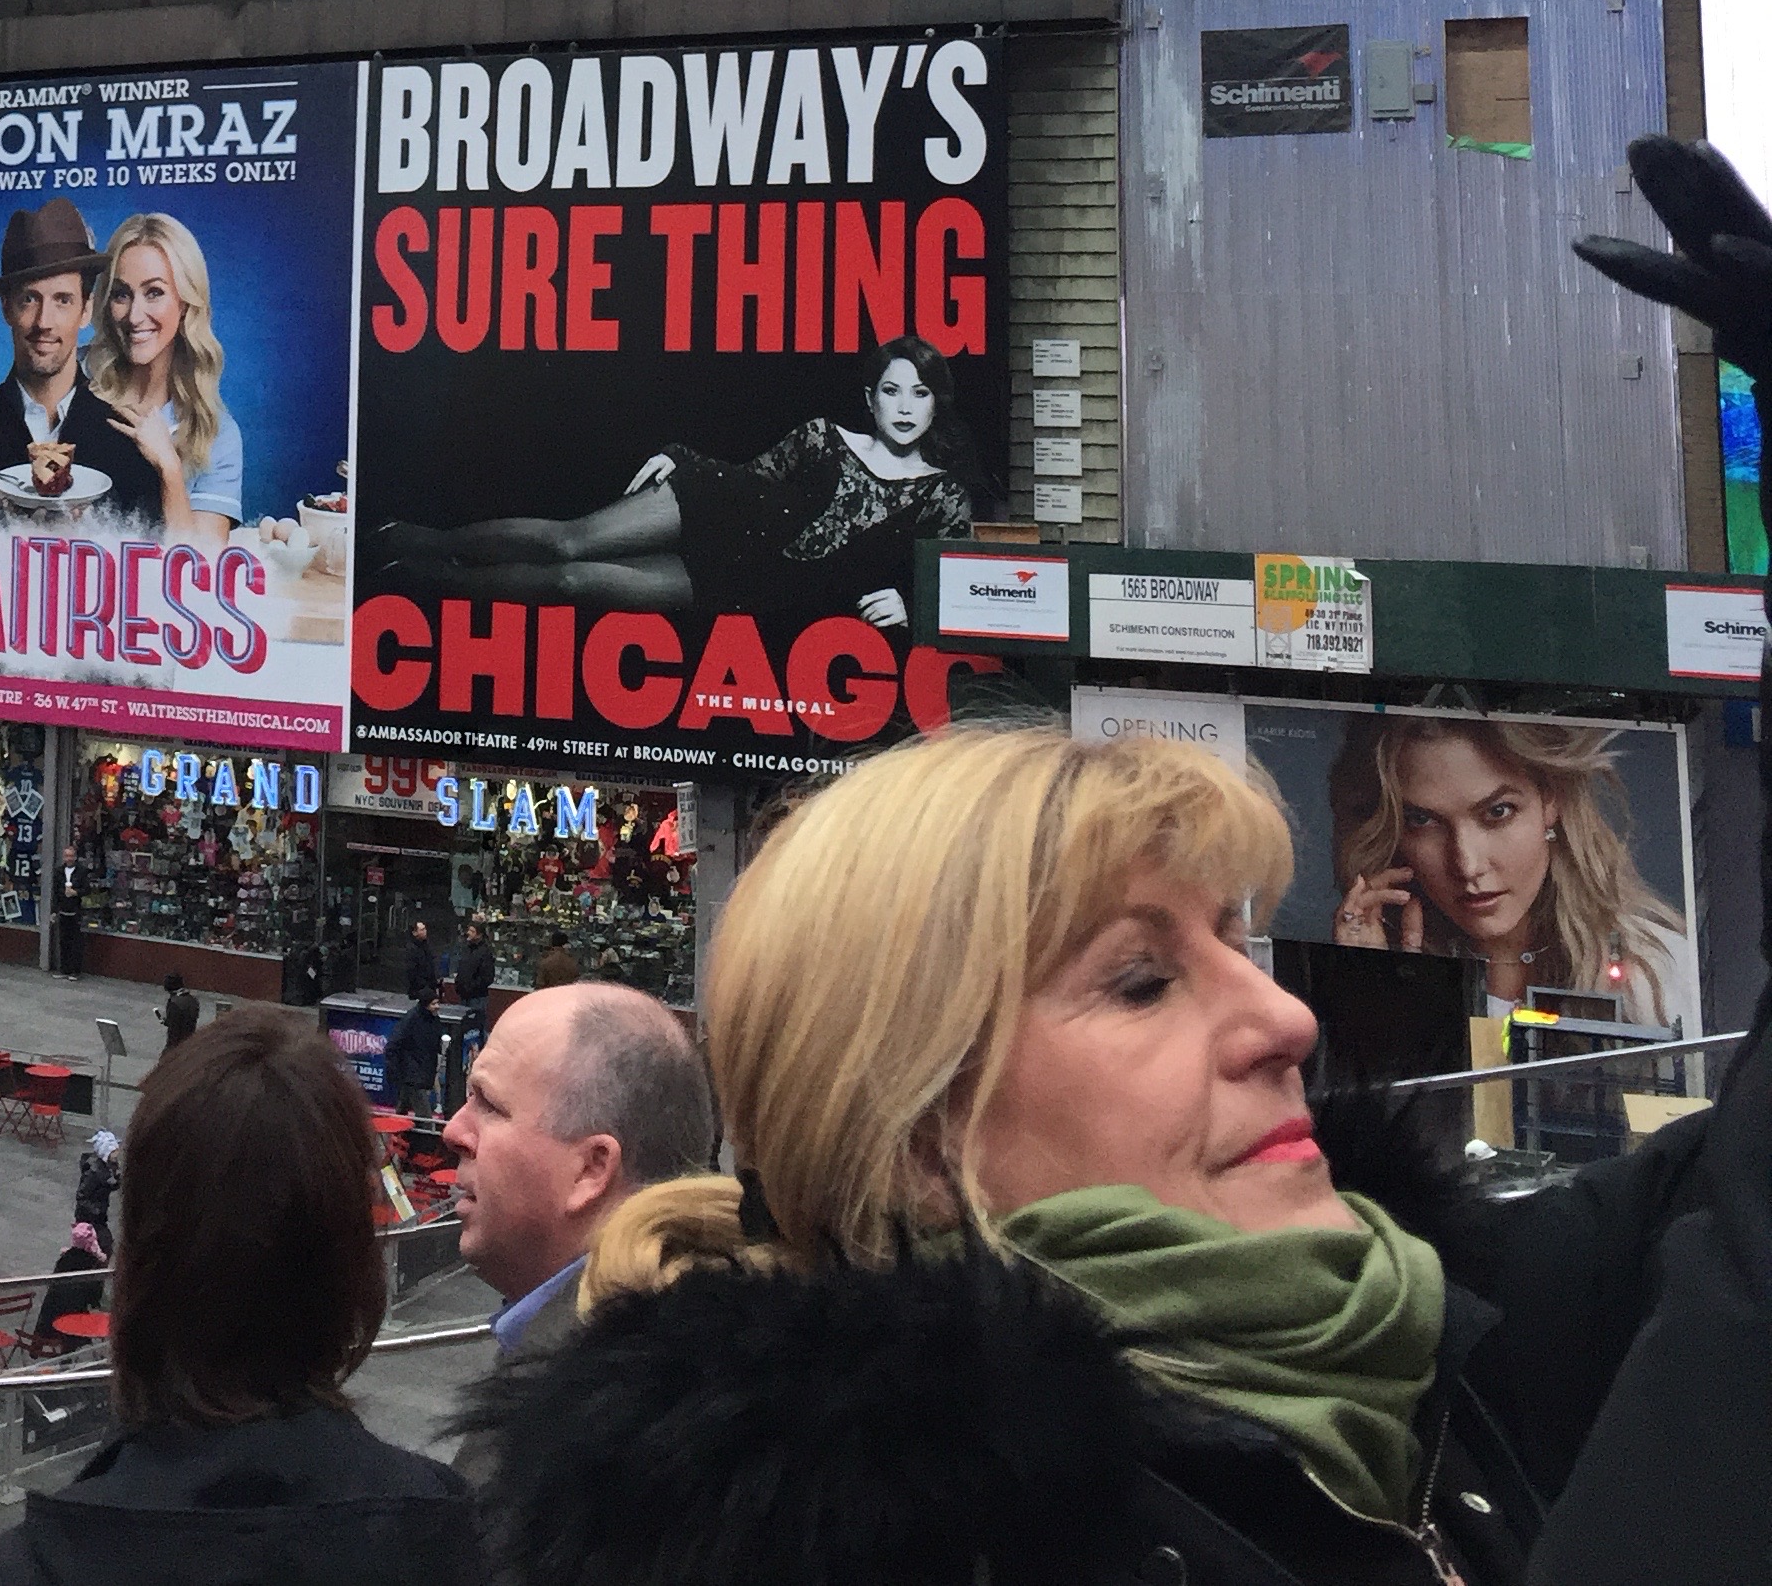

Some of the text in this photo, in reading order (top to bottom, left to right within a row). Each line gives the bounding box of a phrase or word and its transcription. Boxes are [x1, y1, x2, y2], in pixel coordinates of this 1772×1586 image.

[1210, 79, 1340, 105] Schimenti
[106, 99, 298, 160] MRAZ
[378, 40, 987, 193] BROADWAY'S
[55, 168, 97, 188] FOR
[106, 166, 129, 186] 10
[137, 163, 217, 185] WEEKS
[225, 160, 297, 182] ONLY!
[372, 198, 986, 357] SURE THING
[969, 581, 1037, 599] Schimenti
[1122, 578, 1219, 602] 1565 BROADWAY
[1109, 624, 1235, 639] SCHIMENTI CONSTRUCTION
[1306, 634, 1363, 653] 718.392.4921
[56, 696, 70, 709] W.
[101, 700, 118, 714] ST
[128, 701, 330, 735] WAITRESSTHEMUSICAL.COM
[696, 693, 836, 716] THE MUSICAL
[1101, 715, 1218, 744] OPENING
[369, 725, 716, 767] AMBASSADOR THEATRE 49TH STREET AT BROADWAY
[141, 749, 599, 840] GRAND SLAM
